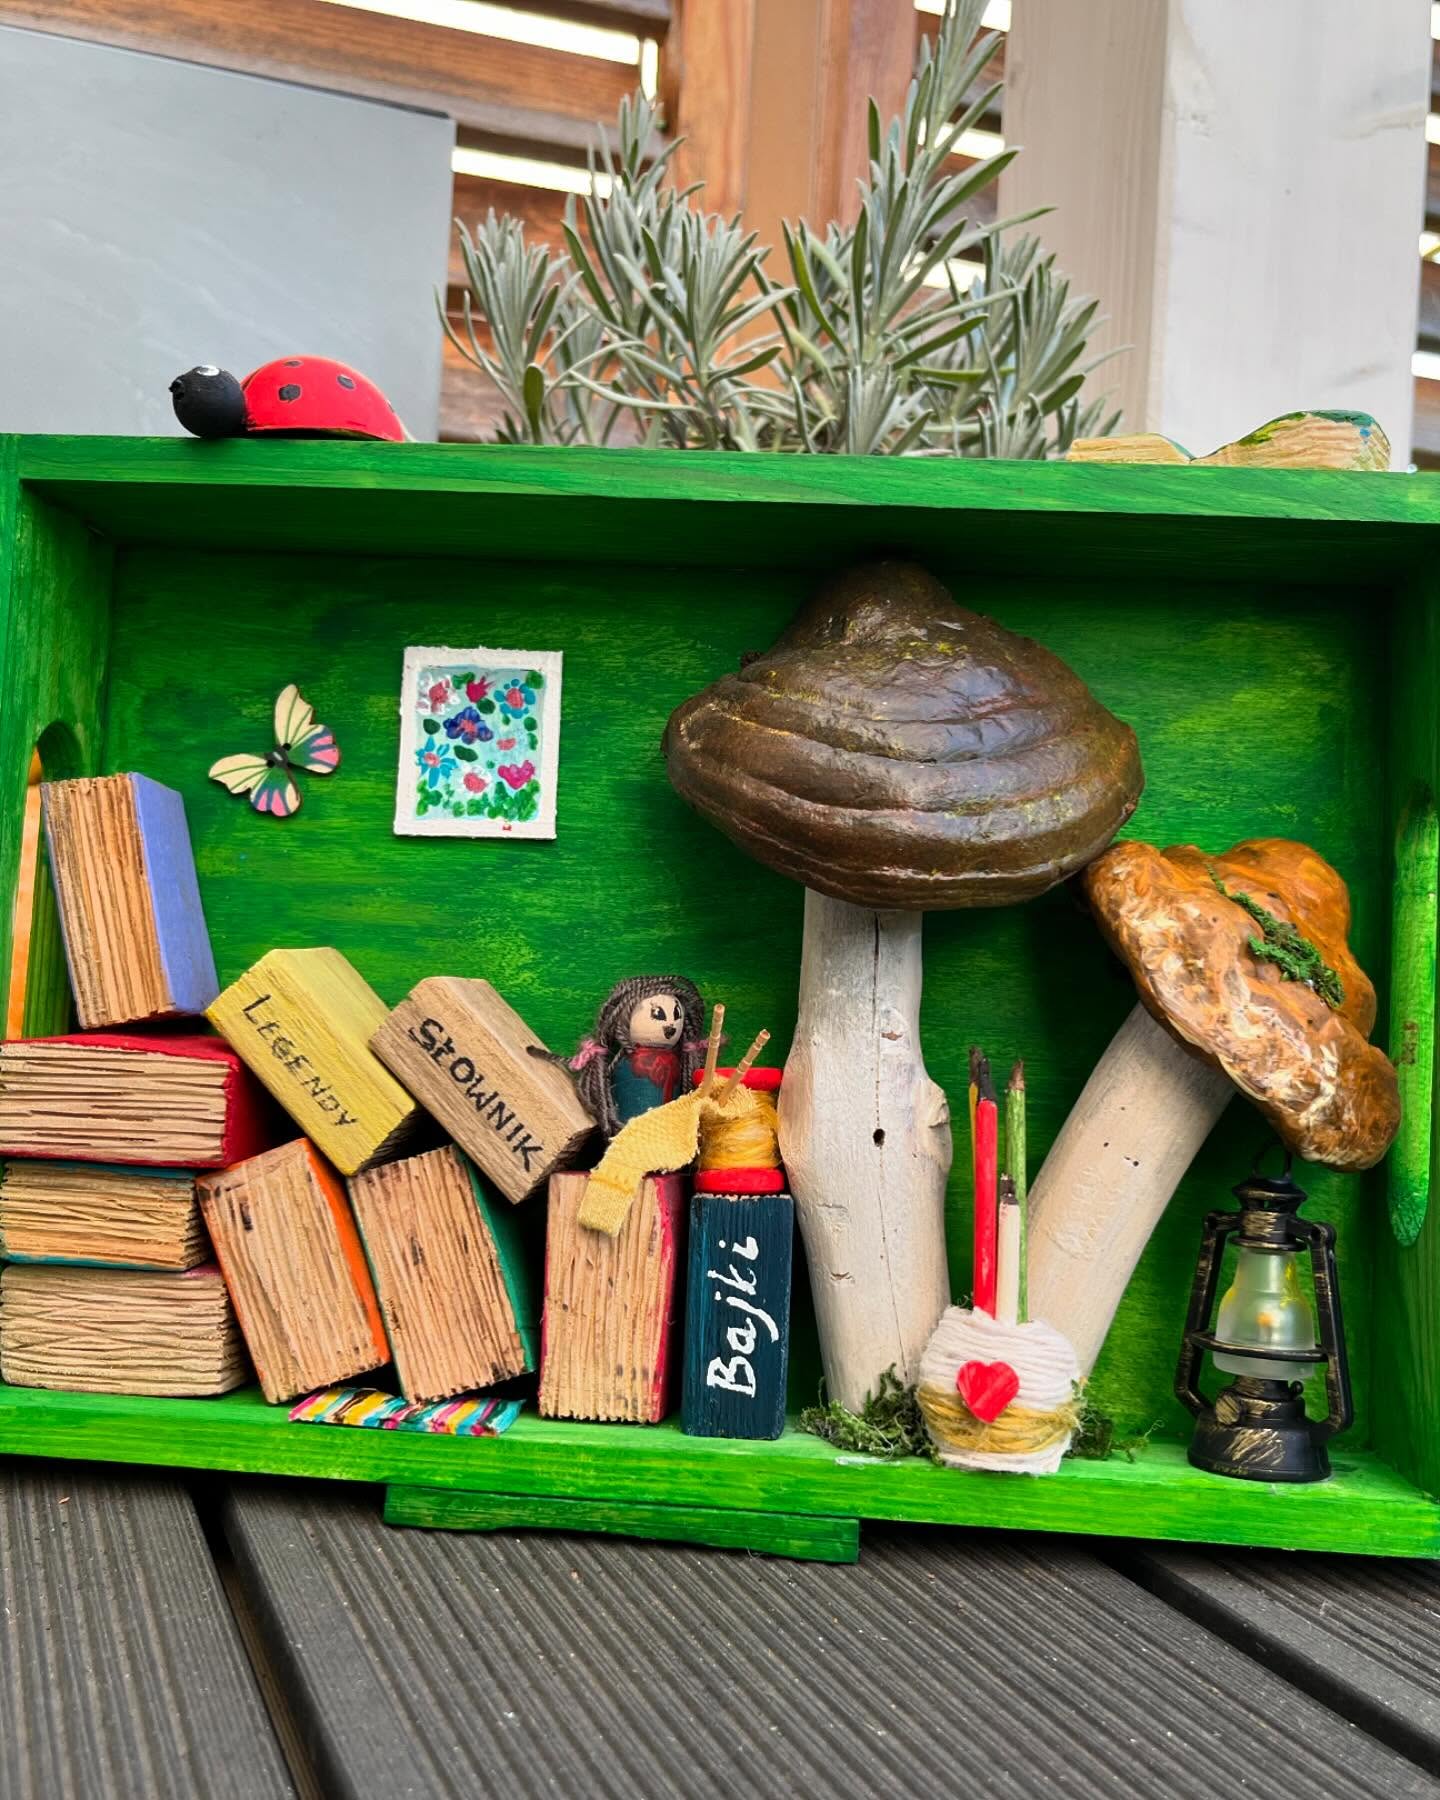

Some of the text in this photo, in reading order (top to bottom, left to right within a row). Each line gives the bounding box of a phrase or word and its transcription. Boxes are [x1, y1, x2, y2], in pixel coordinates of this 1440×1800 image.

[241, 994, 357, 1127] LEGENDY
[408, 1018, 544, 1172] SŁOWNIK
[707, 1236, 780, 1398] Bajki
